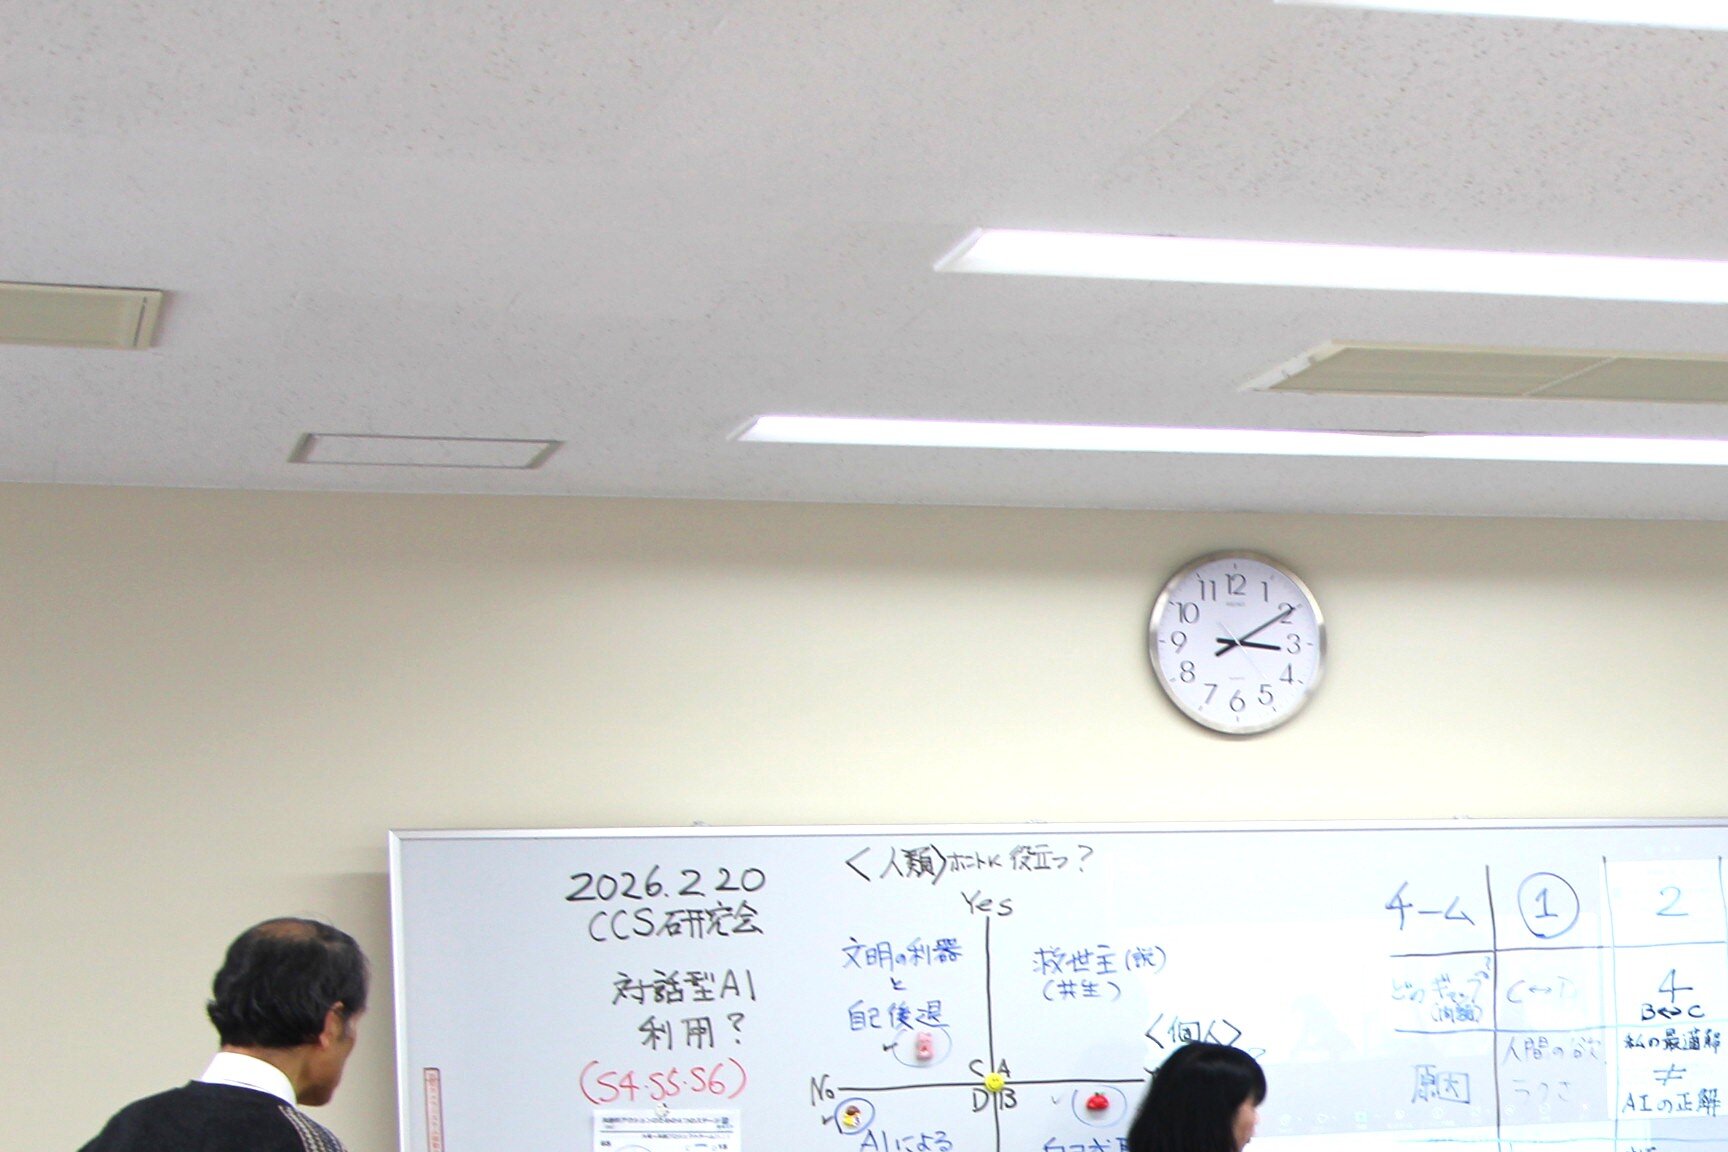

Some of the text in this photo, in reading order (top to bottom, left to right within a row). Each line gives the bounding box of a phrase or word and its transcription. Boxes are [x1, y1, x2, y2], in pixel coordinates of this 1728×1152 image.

[1198, 579, 1217, 601] 11
[1225, 573, 1246, 596] 12
[1261, 581, 1268, 602] 1
[1176, 602, 1199, 624] 10
[1277, 602, 1295, 625] 2
[1170, 631, 1187, 654] 9
[1286, 633, 1301, 654] 3
[1179, 660, 1196, 683] 8
[1279, 662, 1294, 685] 4
[1204, 683, 1218, 704] 7
[1229, 689, 1246, 712] 6
[1257, 684, 1273, 705] 5
[961, 890, 1013, 916] Yes
[1385, 880, 1475, 930] チーム
[1656, 886, 1688, 917] 2
[589, 900, 764, 942] CCS研究会
[842, 937, 962, 972] 文明の利器
[612, 969, 757, 1005] 対話型AI
[1658, 968, 1694, 1003] 4
[1641, 1003, 1705, 1021] B C
[969, 1058, 1011, 1077] C A
[810, 1075, 835, 1107] No
[972, 1092, 989, 1112] D
